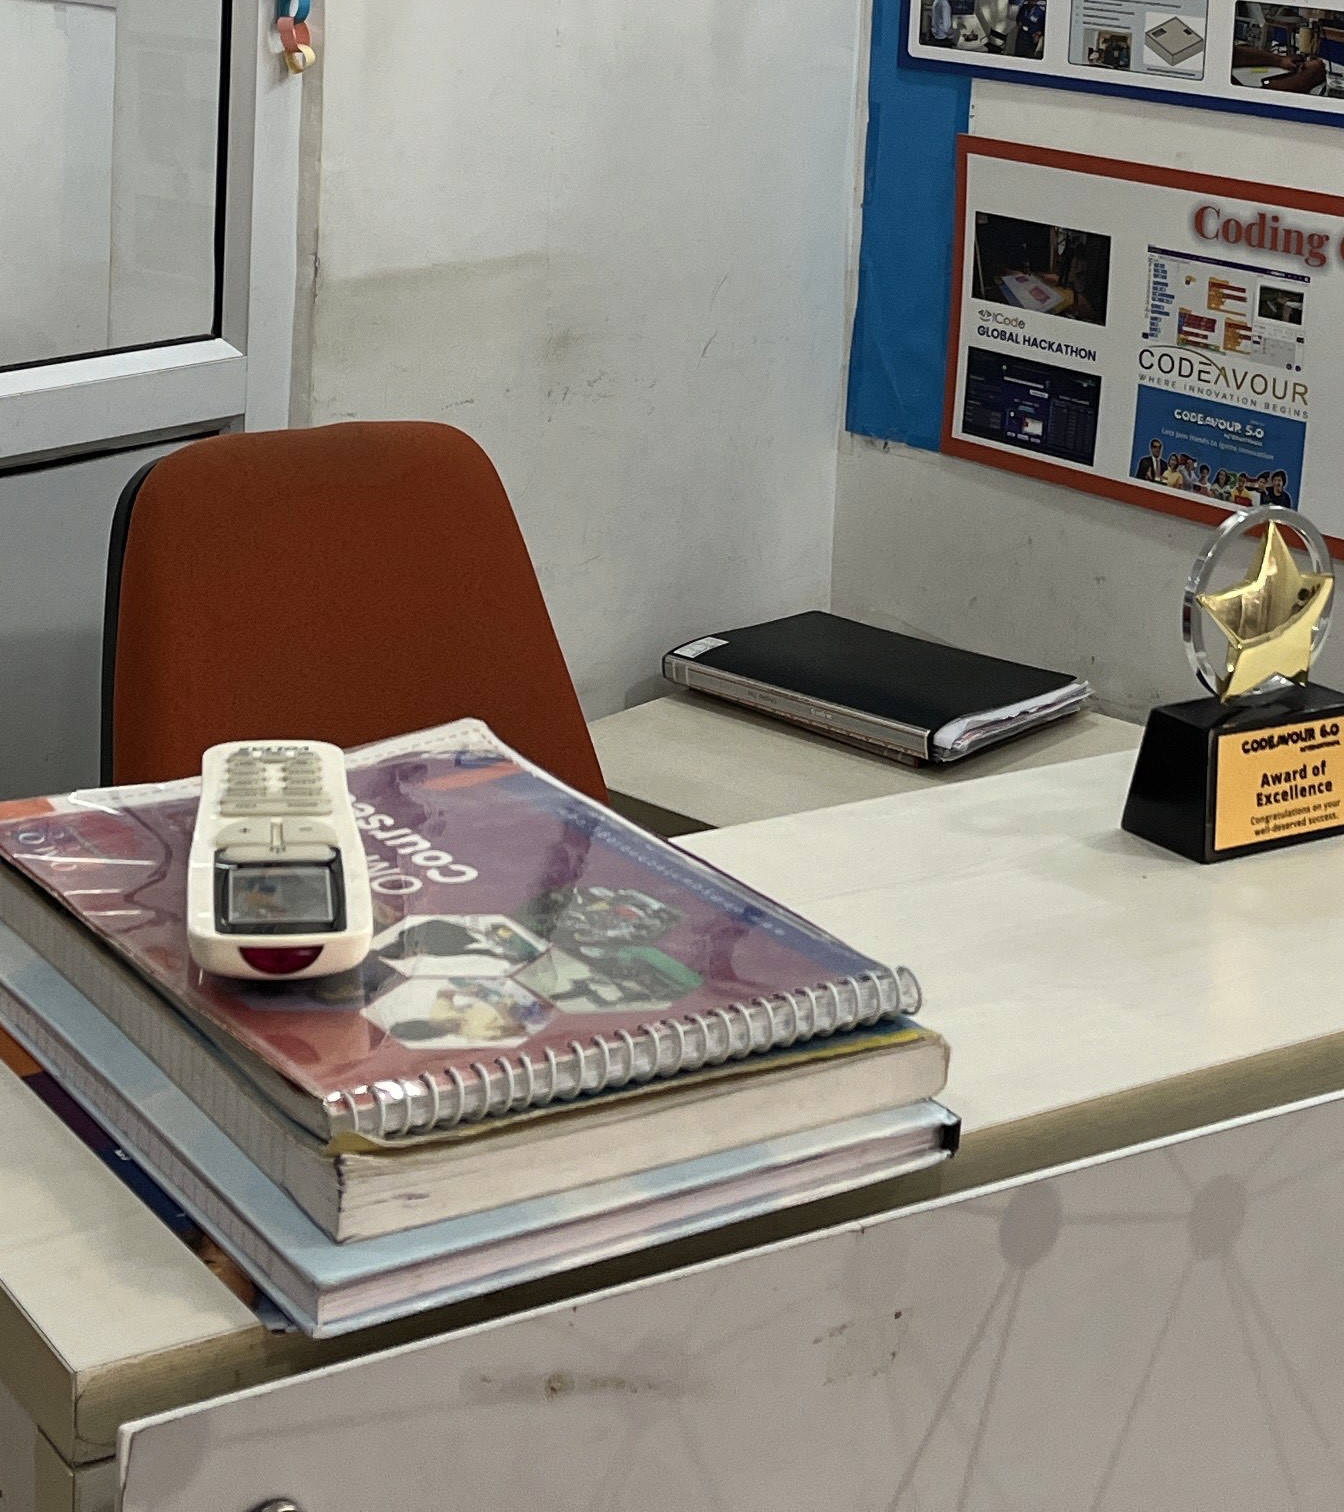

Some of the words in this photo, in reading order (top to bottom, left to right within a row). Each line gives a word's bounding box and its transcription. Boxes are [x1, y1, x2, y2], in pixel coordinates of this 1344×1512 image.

[1192, 204, 1329, 268] Coding
[977, 325, 1020, 346] GLOBAL
[1022, 335, 1097, 363] HACKATHON
[1138, 373, 1177, 390] WHERE
[1184, 379, 1257, 407] INNOVATION
[1264, 402, 1310, 420] BEGINS
[1320, 723, 1340, 738] 6.0
[1260, 763, 1307, 788] Award
[1312, 759, 1327, 776] of
[1256, 780, 1333, 807] Excellence
[1250, 803, 1311, 826] Congratulations
[1312, 802, 1322, 812] on
[1323, 799, 1341, 812] your
[1254, 817, 1306, 836] well-deserved
